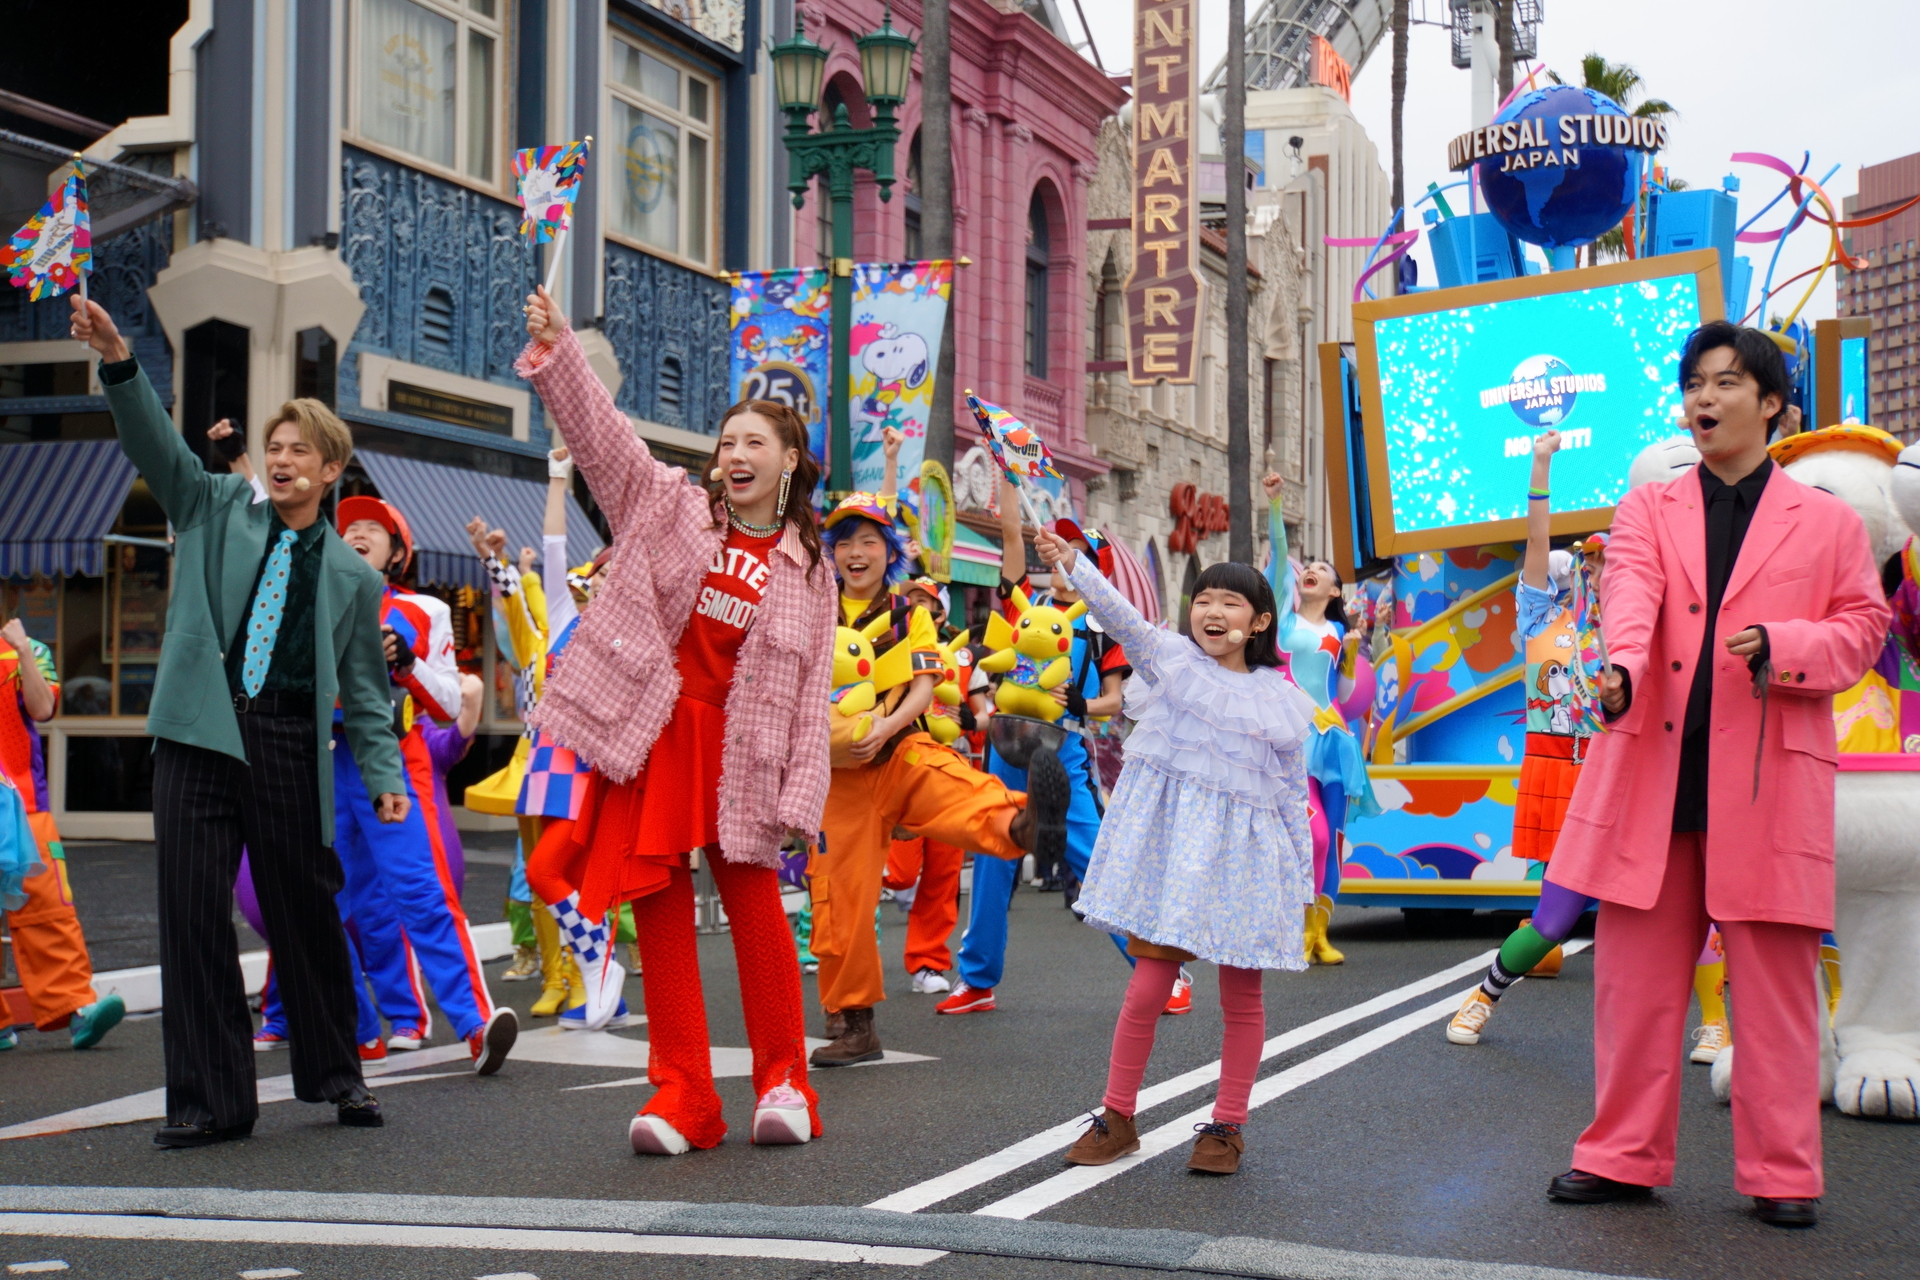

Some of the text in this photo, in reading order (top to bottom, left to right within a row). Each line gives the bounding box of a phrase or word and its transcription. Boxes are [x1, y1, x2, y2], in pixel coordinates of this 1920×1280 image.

[1450, 114, 1667, 169] NIVERSAL STUDIOS
[1500, 148, 1580, 172] JAPAN
[1141, 0, 1184, 374] NTMARTRE
[1480, 373, 1606, 409] UNIVERSAL STUDIOS
[1524, 395, 1563, 410] JAPAN
[1504, 435, 1532, 458] NO
